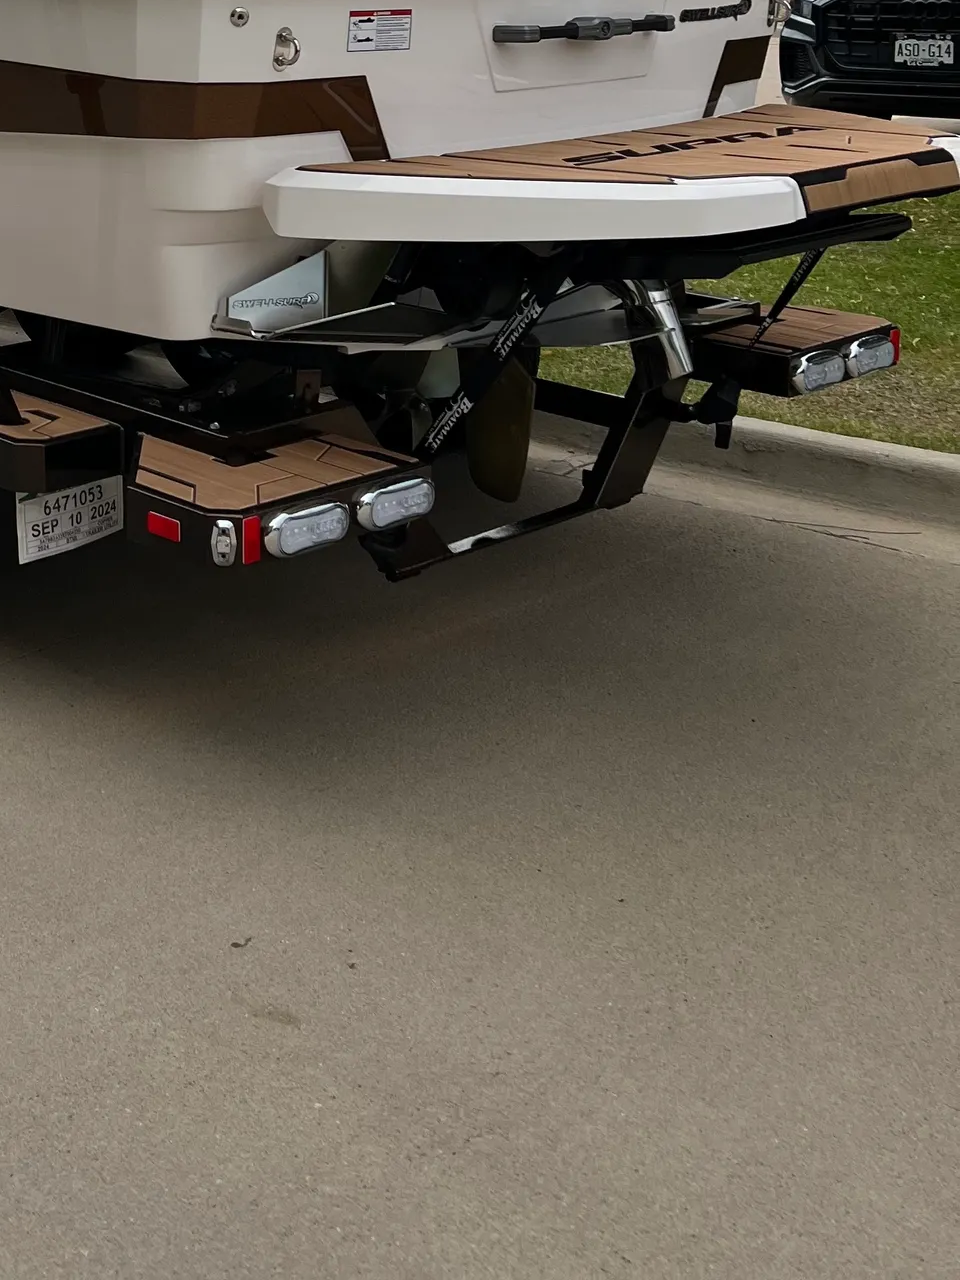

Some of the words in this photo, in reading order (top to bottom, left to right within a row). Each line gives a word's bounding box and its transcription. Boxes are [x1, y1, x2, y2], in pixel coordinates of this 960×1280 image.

[562, 126, 826, 167] SUPRA
[232, 297, 308, 309] SWELLSURF
[43, 484, 103, 516] 6471053
[31, 518, 59, 538] SEP
[68, 511, 82, 527] 10
[90, 499, 117, 520] 2024
